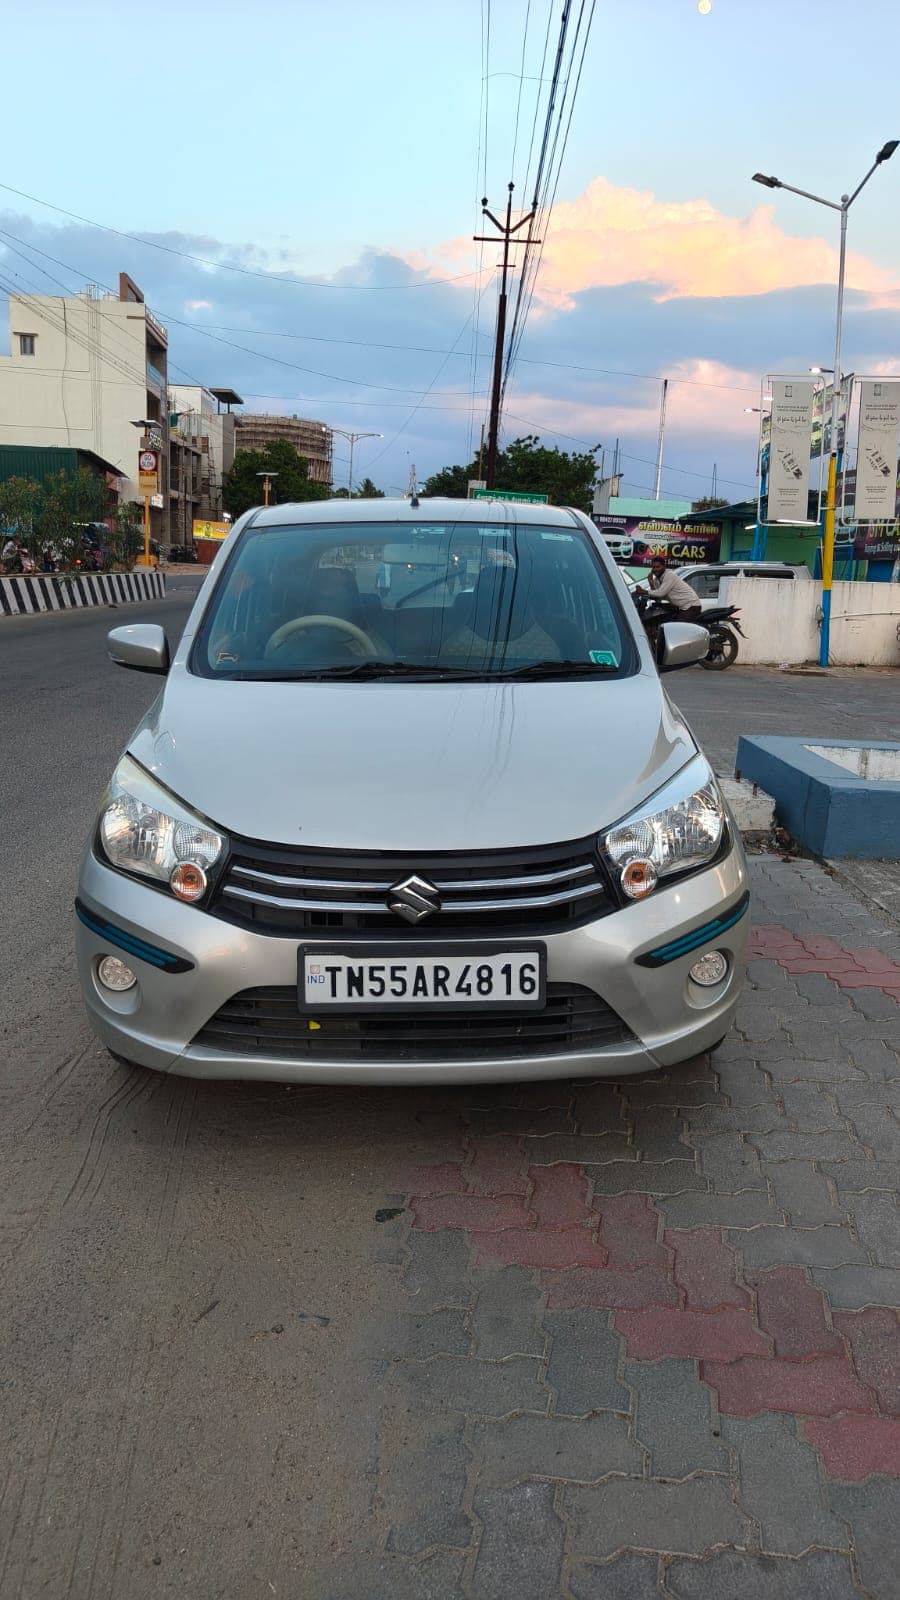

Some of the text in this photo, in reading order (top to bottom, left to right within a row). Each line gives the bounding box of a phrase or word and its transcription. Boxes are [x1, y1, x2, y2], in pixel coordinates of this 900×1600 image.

[649, 544, 706, 559] SM CARS
[307, 975, 325, 985] IND
[325, 964, 537, 997] TN55AR4816
